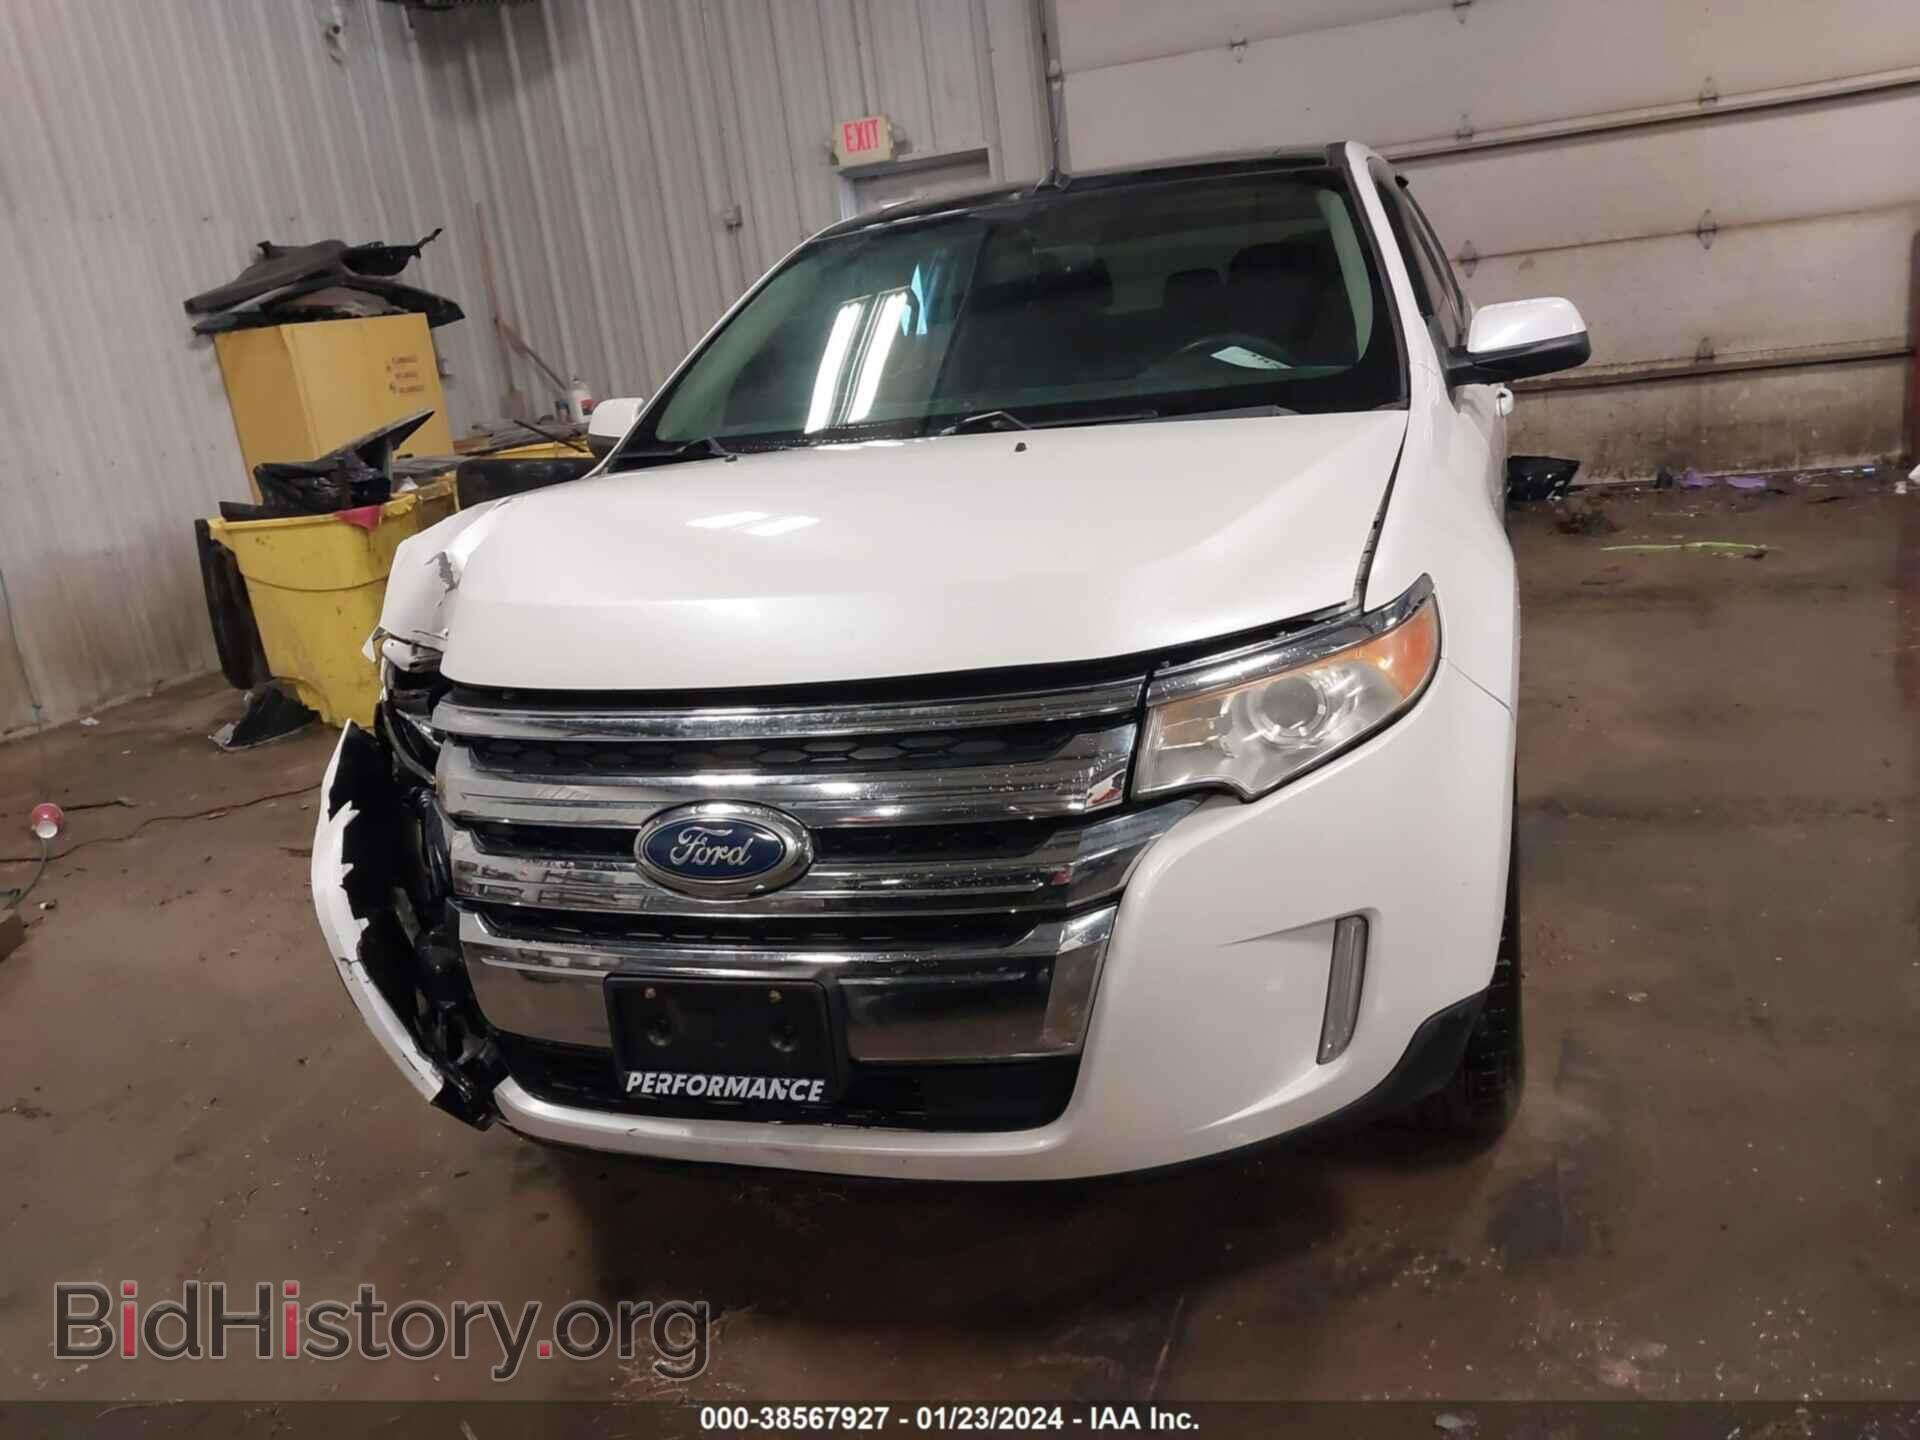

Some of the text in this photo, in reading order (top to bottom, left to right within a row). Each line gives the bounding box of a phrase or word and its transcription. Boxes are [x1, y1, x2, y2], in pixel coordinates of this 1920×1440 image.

[843, 119, 881, 153] EXIT
[671, 826, 753, 866] Ford
[626, 1072, 825, 1102] PERFORMANCE
